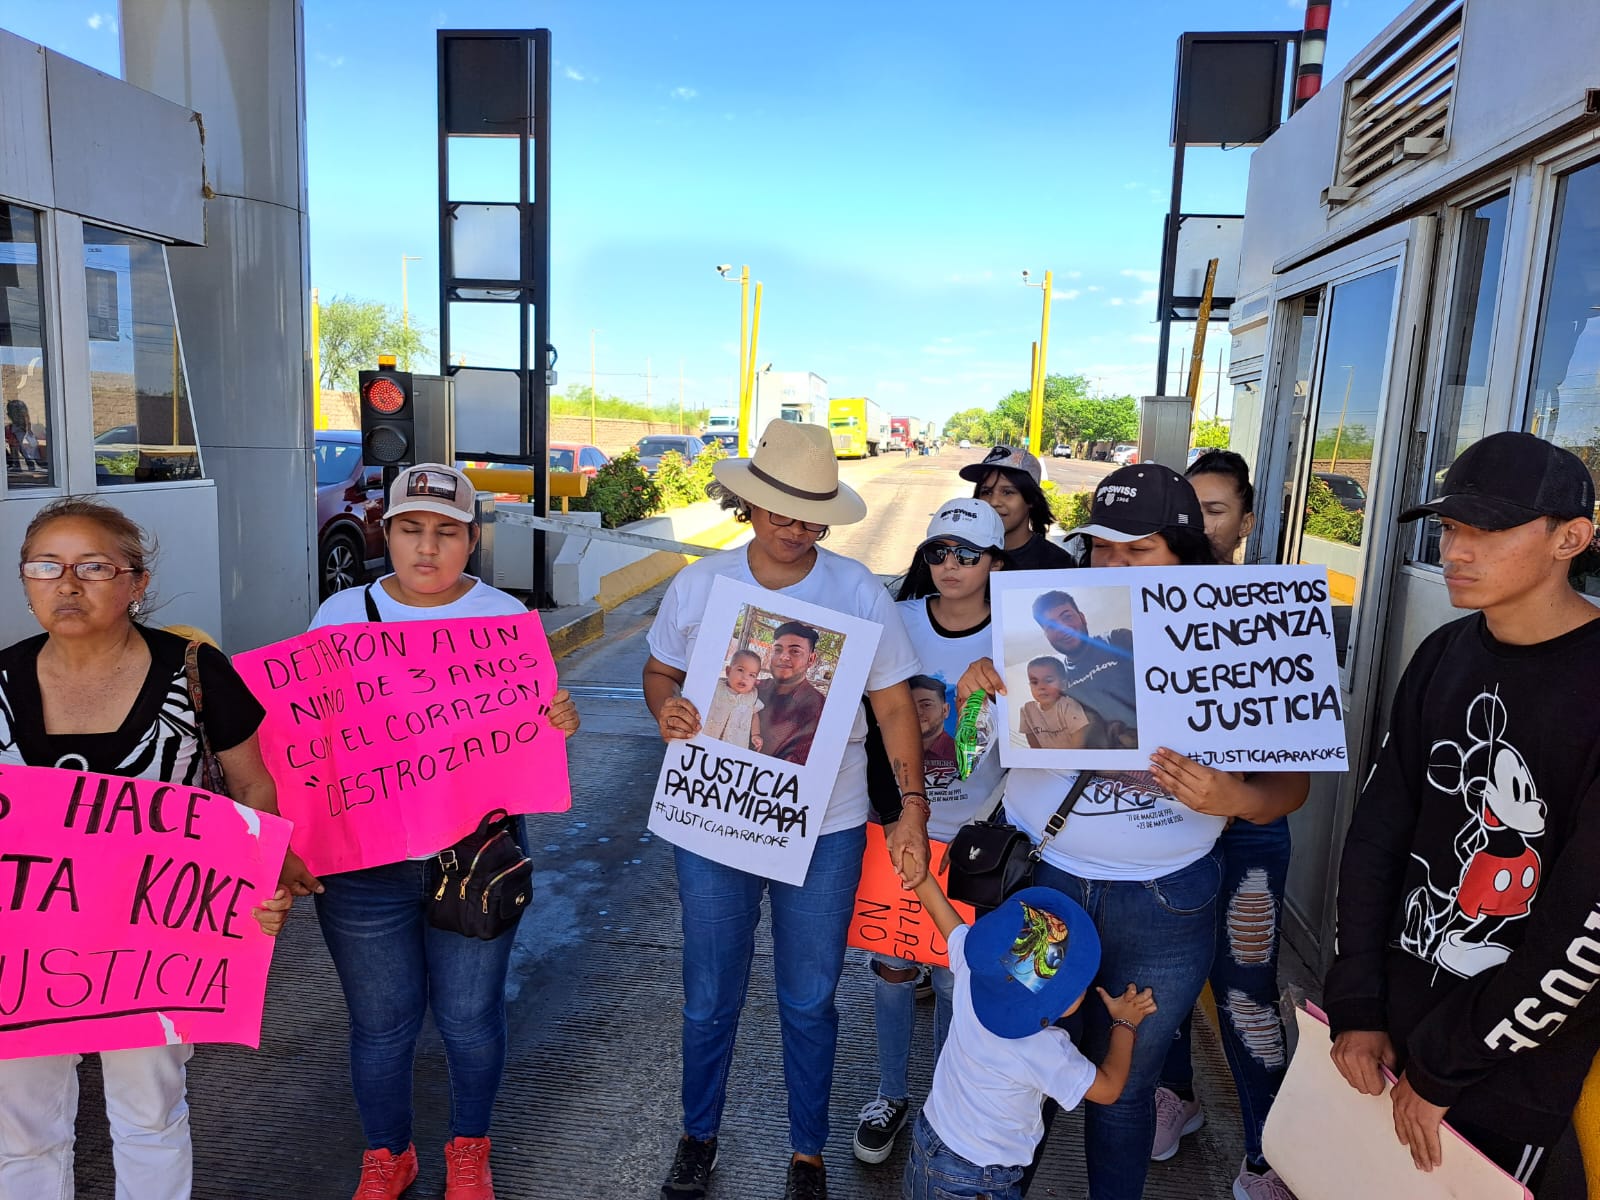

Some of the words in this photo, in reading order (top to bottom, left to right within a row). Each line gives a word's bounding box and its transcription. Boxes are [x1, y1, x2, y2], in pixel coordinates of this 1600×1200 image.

[1142, 583, 1187, 613] NO
[1193, 579, 1327, 611] QUEREMOS
[432, 629, 456, 653] A
[469, 625, 518, 649] UN
[1164, 606, 1331, 652] VENGANZA,
[290, 686, 345, 725] NIÑO
[356, 676, 391, 705] DE
[408, 668, 436, 692] 3
[448, 652, 538, 684] AÑOS
[1145, 653, 1315, 695] QUEREMOS
[286, 731, 334, 769] CON
[342, 727, 373, 751] EL
[385, 680, 541, 742] CORAZÓN
[1187, 684, 1342, 732] JUSTICIA
[681, 743, 799, 804] JUSTICIA
[1187, 745, 1346, 766] #JUSTICIAPARAKOKE
[64, 776, 211, 840] HACE
[655, 801, 790, 848] #JUSTICIAPARAKOKE
[0, 853, 79, 912] TA
[130, 854, 255, 939] KOKE
[857, 898, 892, 942] NO
[892, 881, 922, 961] ALAS
[0, 948, 231, 1016] USTICIA
